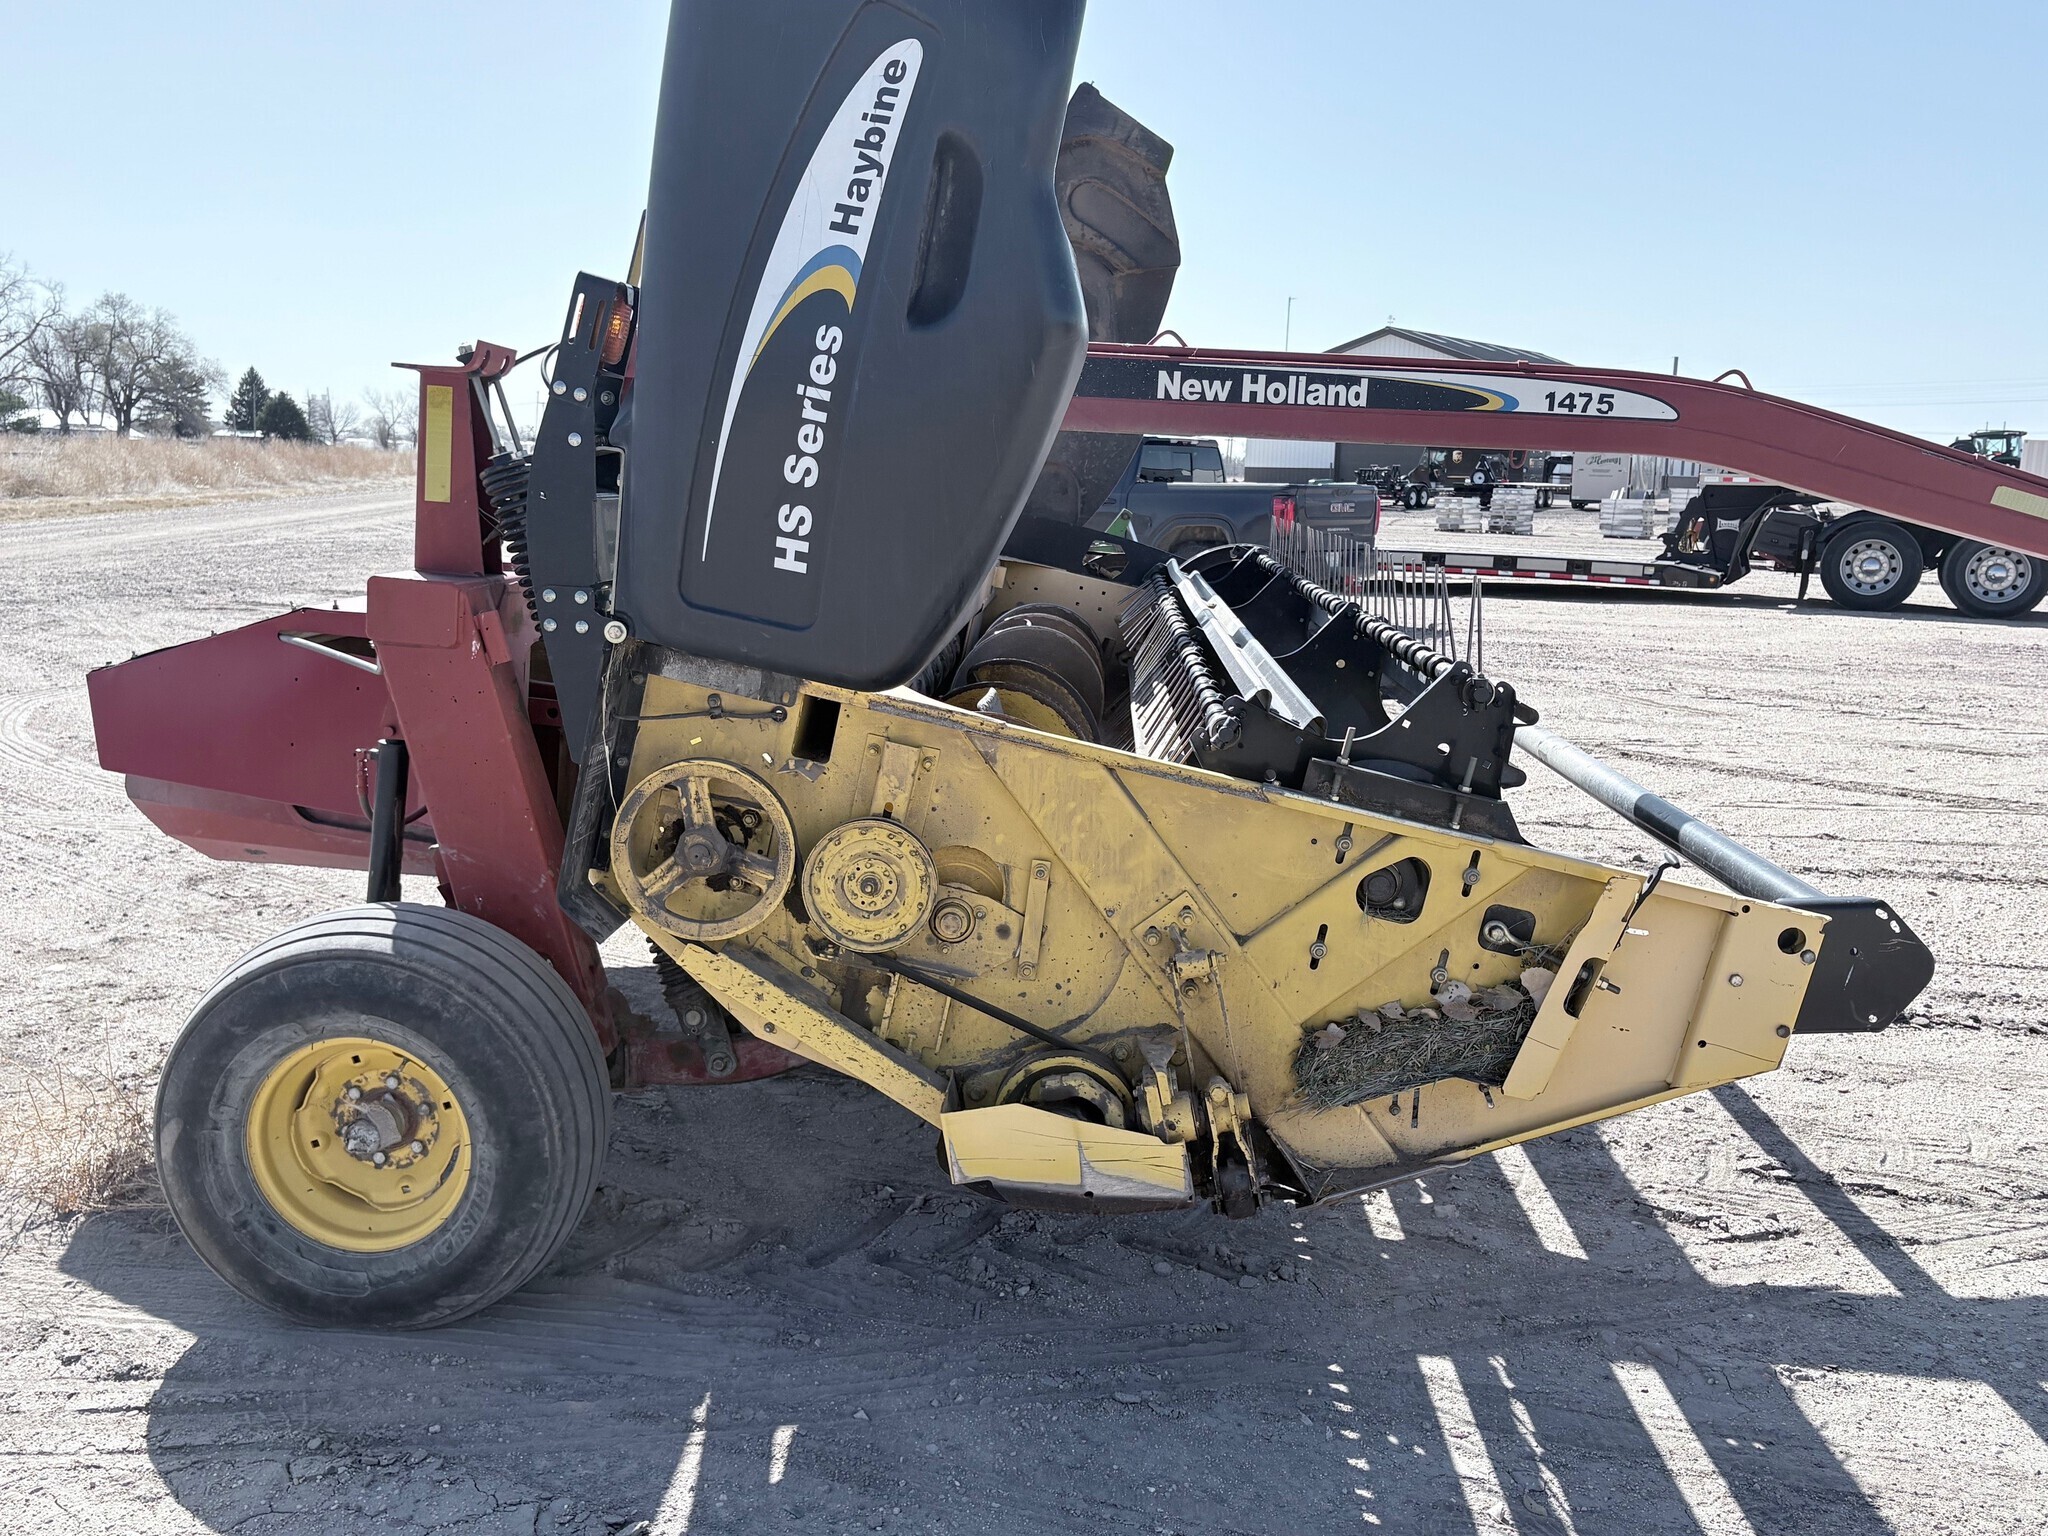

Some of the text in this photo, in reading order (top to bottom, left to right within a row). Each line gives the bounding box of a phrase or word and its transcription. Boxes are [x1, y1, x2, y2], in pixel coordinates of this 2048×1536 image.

[829, 59, 907, 235] Haybine
[1157, 370, 1369, 408] New Holland
[1545, 391, 1615, 415] 1475
[774, 324, 843, 574] HS Series
[1330, 503, 1355, 512] GMC
